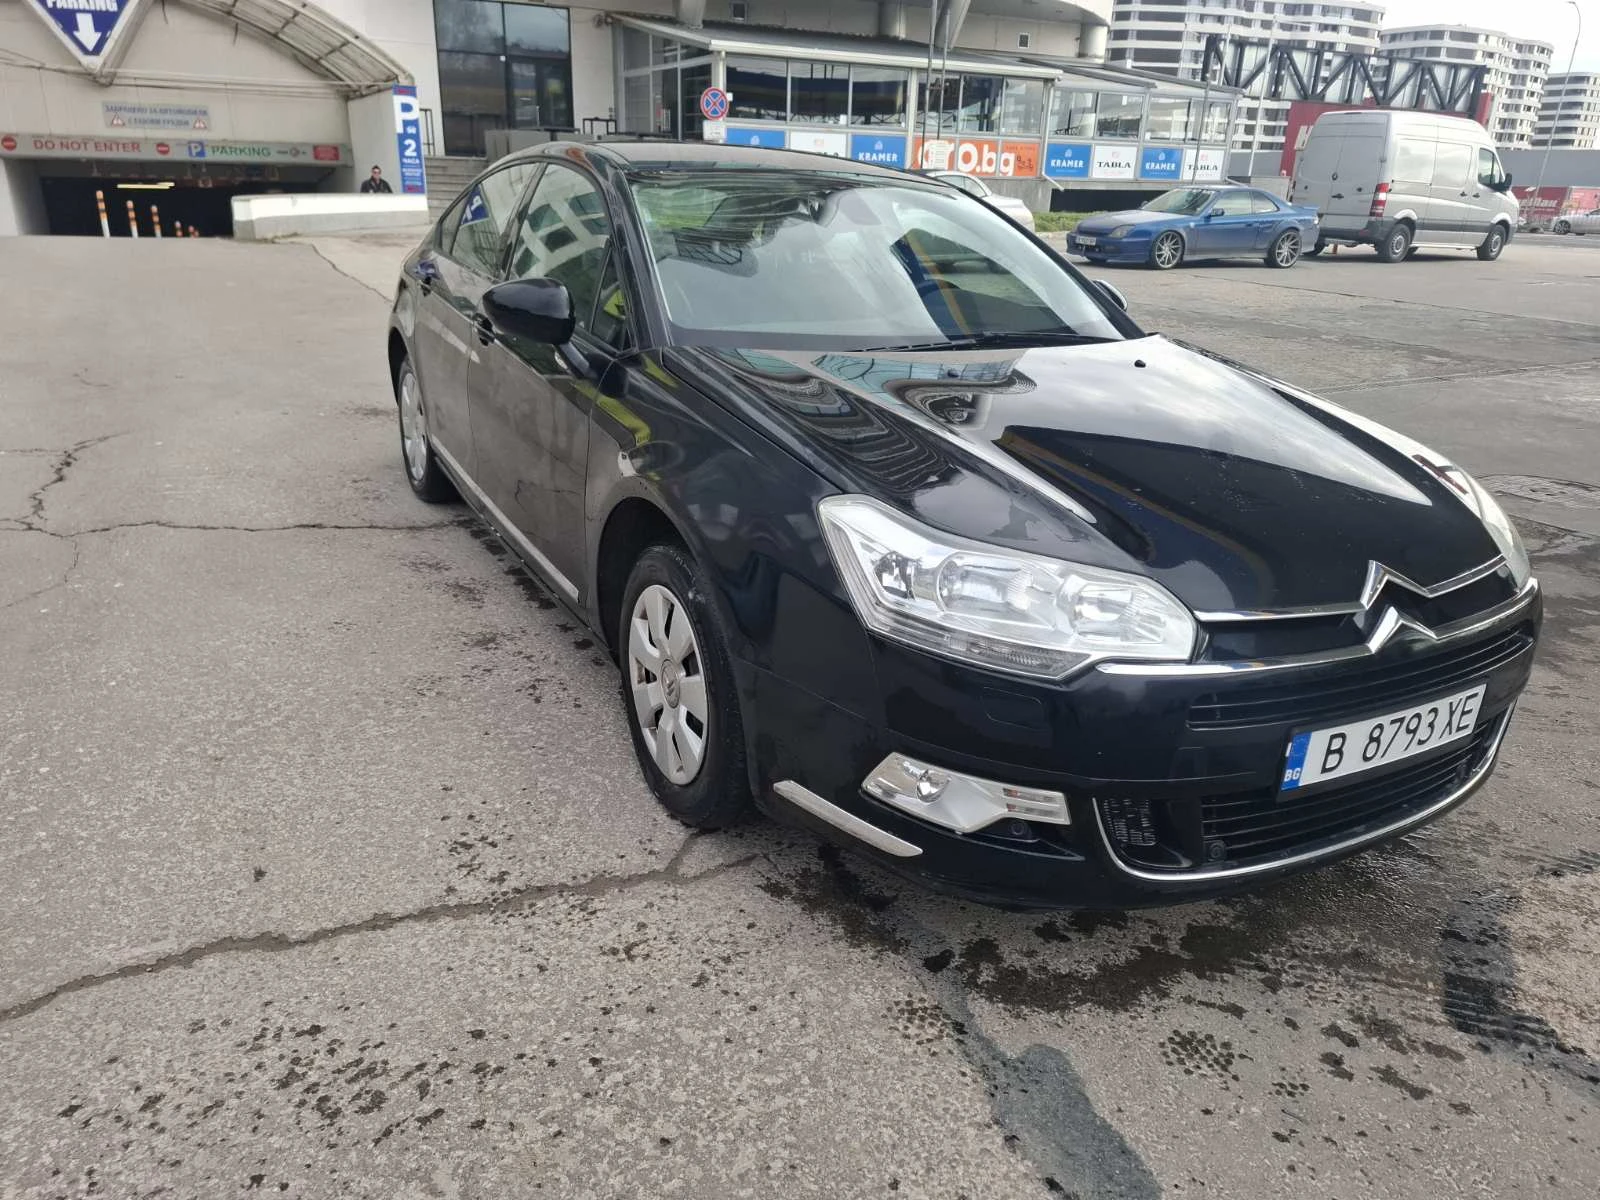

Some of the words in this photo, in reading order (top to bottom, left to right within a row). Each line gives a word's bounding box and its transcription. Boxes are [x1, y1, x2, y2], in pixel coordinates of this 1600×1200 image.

[393, 95, 419, 133] P
[33, 139, 55, 150] DO
[60, 140, 89, 151] NOT
[95, 142, 141, 152] ENTER
[211, 145, 271, 157] PARKING
[404, 139, 417, 156] 2
[858, 152, 898, 163] KRAMER
[1050, 159, 1084, 168] KRAMER
[1145, 162, 1176, 170] KRAMER
[1321, 732, 1347, 774] B
[1362, 707, 1439, 762] 8793
[1439, 692, 1479, 740] XE
[1283, 769, 1301, 782] BG
